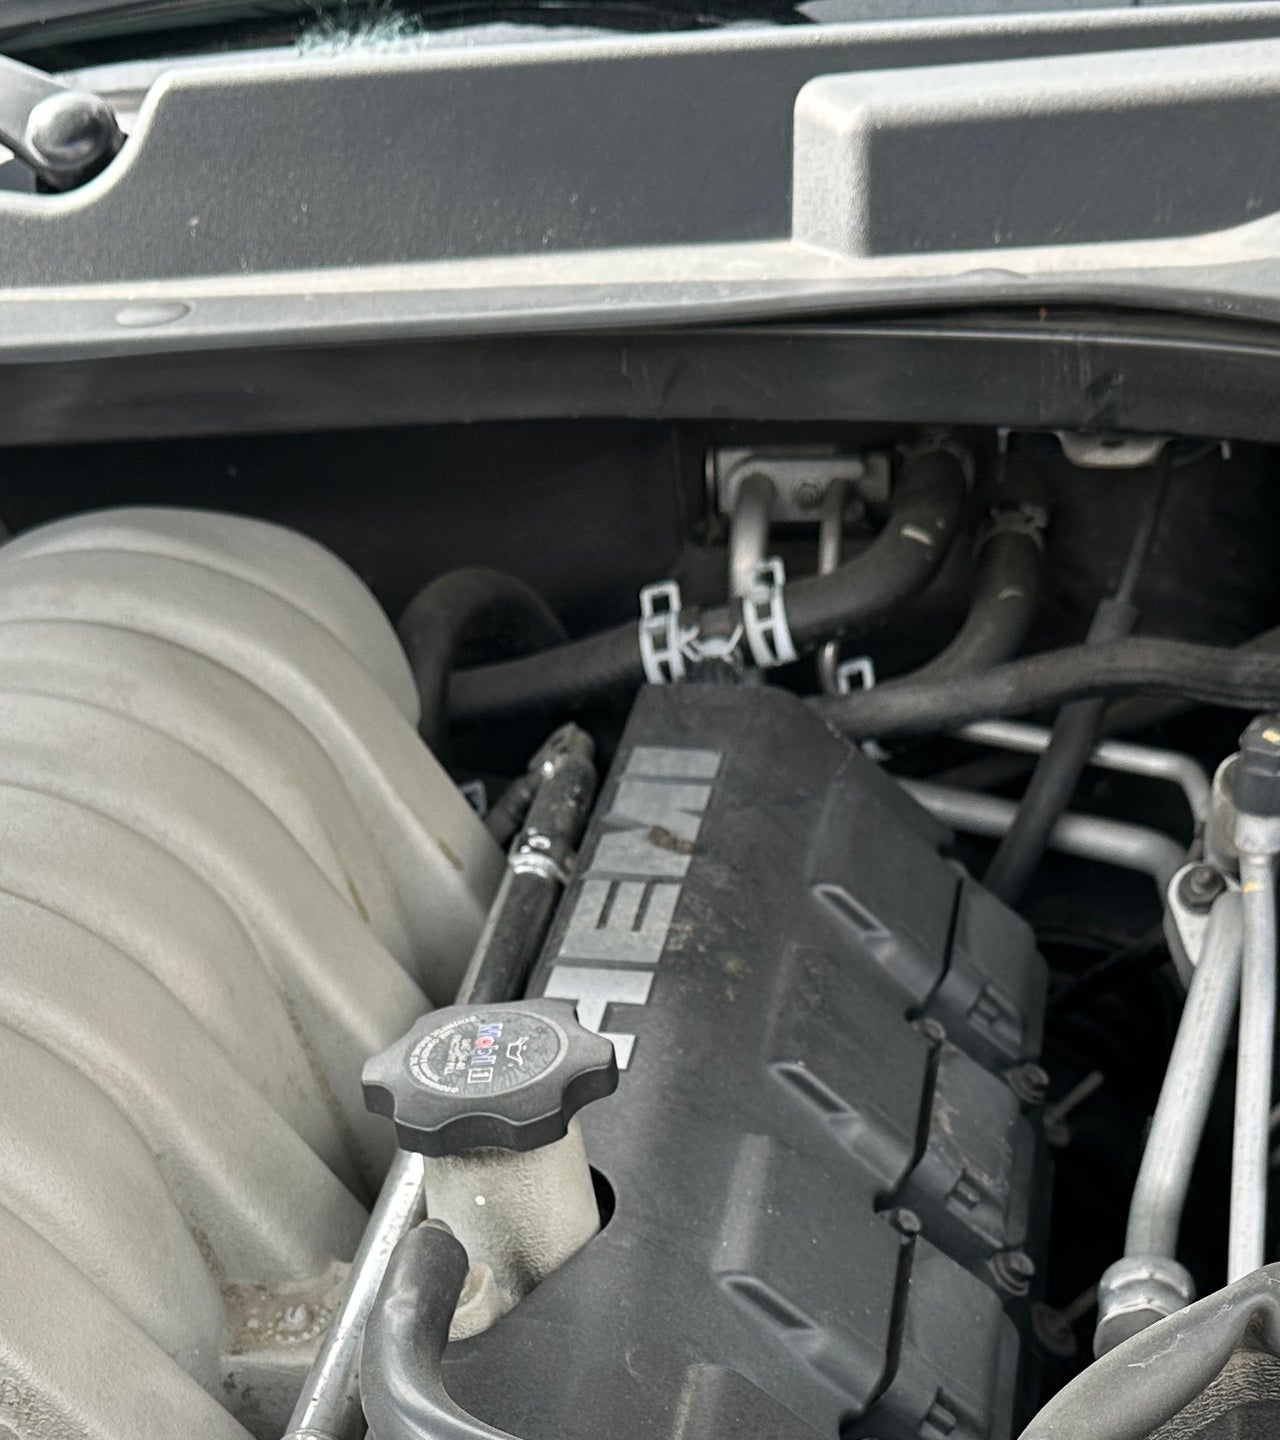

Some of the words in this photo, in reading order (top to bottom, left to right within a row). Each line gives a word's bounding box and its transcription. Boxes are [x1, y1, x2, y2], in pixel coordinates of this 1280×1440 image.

[544, 746, 721, 1070] HEMI
[470, 1023, 504, 1067] Mobil
[468, 1067, 494, 1084] 1
